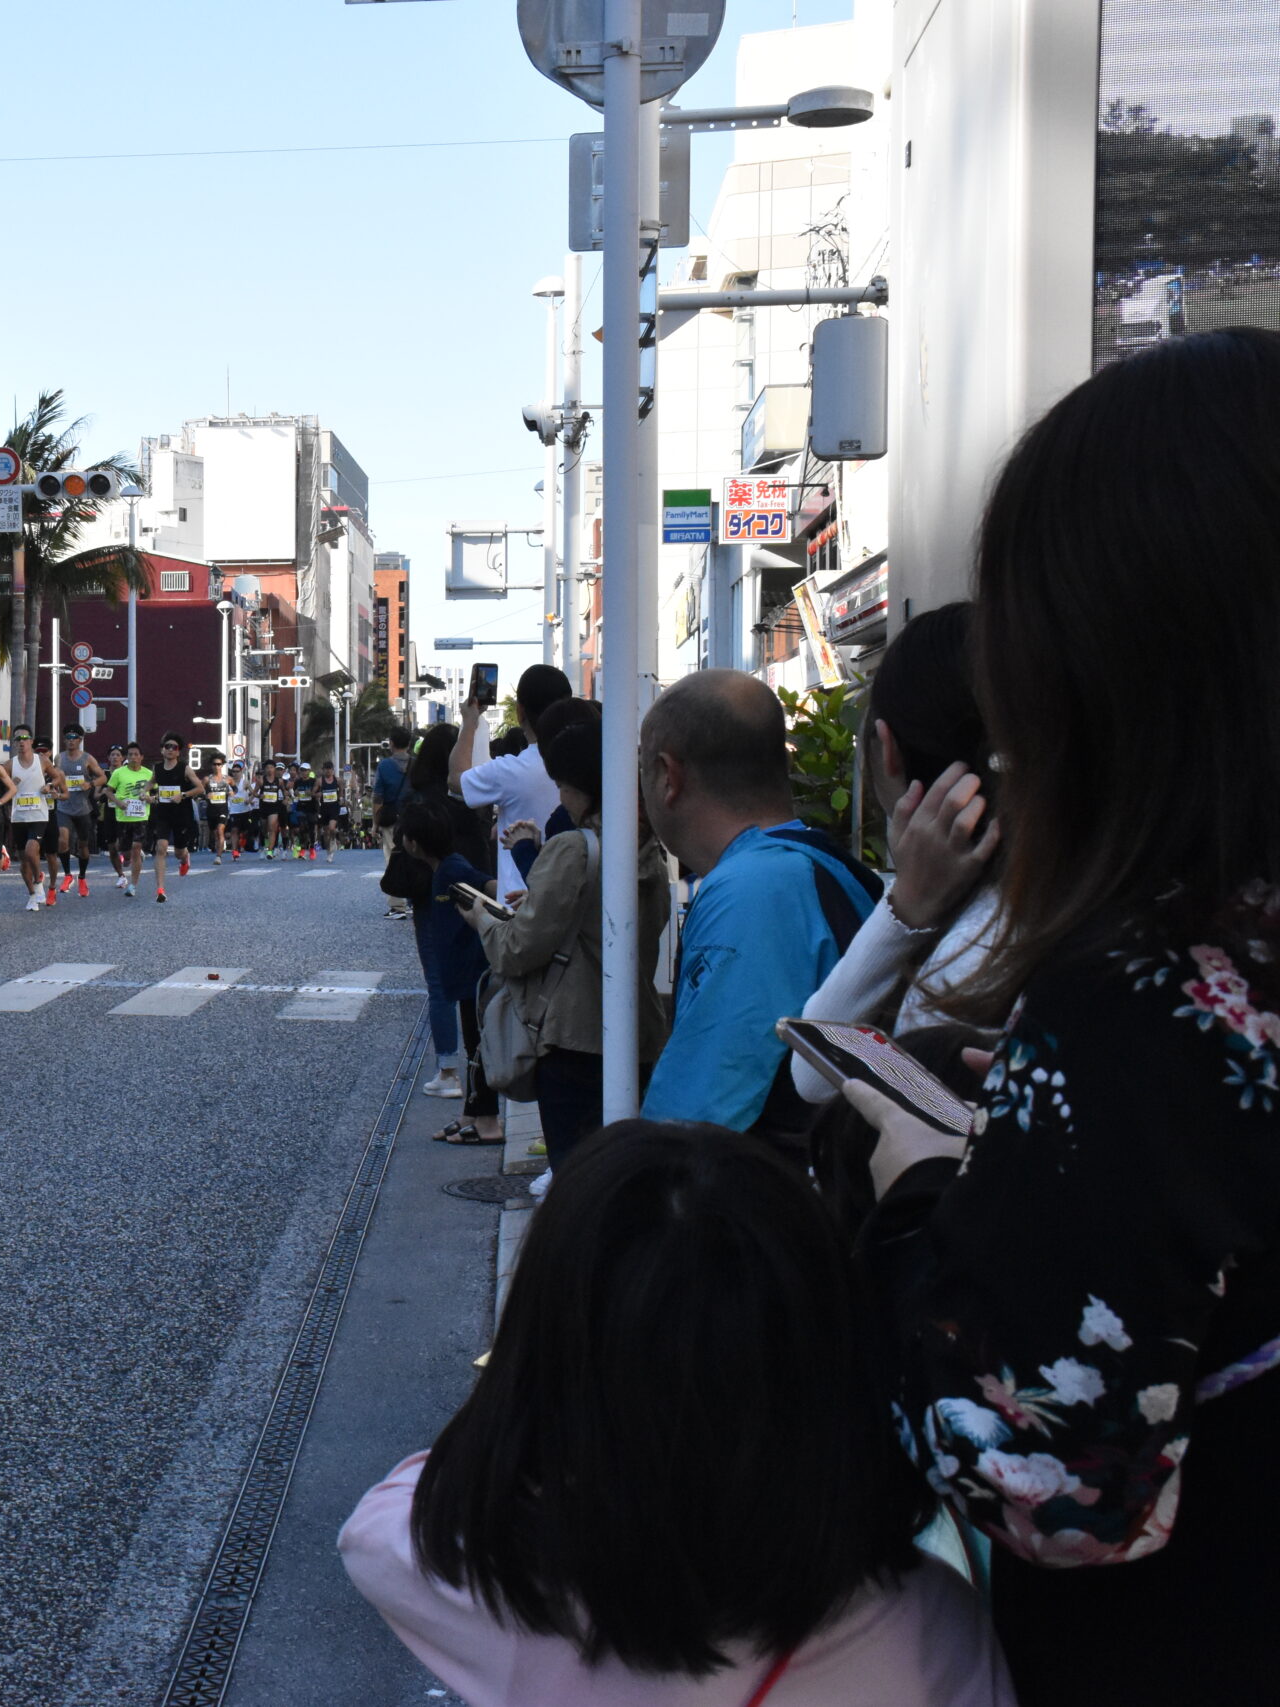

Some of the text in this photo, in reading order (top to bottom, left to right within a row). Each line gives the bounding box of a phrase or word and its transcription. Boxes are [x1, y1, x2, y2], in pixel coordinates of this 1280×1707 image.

[728, 479, 753, 507] 薬
[755, 480, 788, 499] 免税
[757, 500, 785, 508] Tax-Free
[665, 510, 709, 520] FamilyMart
[728, 511, 784, 537] ダイコク
